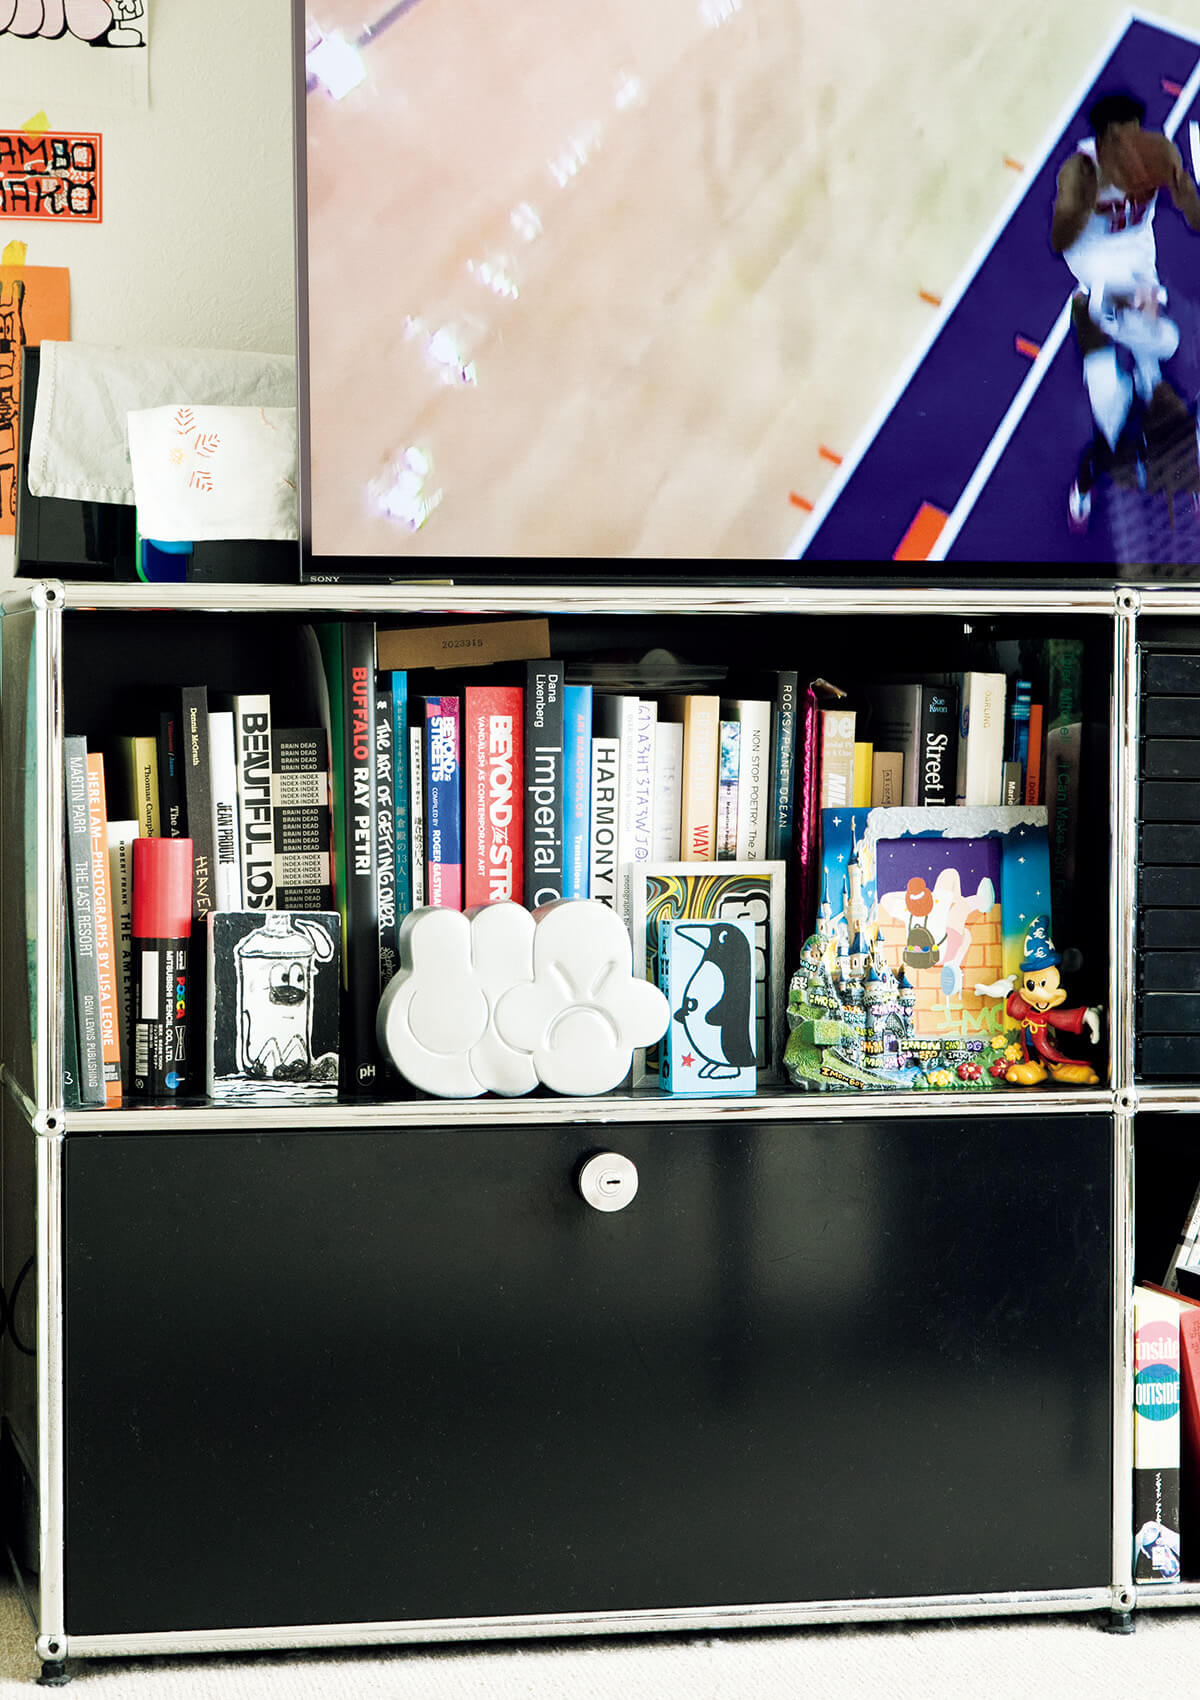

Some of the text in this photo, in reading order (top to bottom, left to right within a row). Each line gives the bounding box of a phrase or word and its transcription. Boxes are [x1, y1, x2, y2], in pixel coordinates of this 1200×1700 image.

[534, 674, 546, 728] Lixenberg
[548, 674, 558, 703] Dana
[932, 696, 945, 705] Sue
[929, 705, 948, 713] Kwon
[431, 716, 444, 783] STREETS
[443, 716, 457, 773] BEYOND
[751, 730, 761, 752] NON
[352, 667, 371, 875] BUFFALO RAY PETRI
[489, 716, 513, 827] BEYOND
[751, 755, 760, 783] STOP
[924, 733, 949, 792] Street
[70, 757, 85, 803] MARTIN
[88, 772, 100, 806] HERE
[144, 765, 152, 801] Thomas
[242, 713, 272, 855] BEAUTIFUL
[377, 786, 392, 806] OF
[477, 716, 487, 877] VANDALISM AS CONTEMPORARY ART
[528, 747, 562, 873] Imperial
[749, 785, 760, 825] POETRY
[73, 805, 87, 834] PARR
[170, 806, 179, 826] The
[217, 802, 233, 827] JEAN
[432, 818, 439, 827] BY
[595, 748, 616, 884] HARMONY
[378, 811, 394, 885] GETTING
[432, 829, 442, 863] ROGER
[693, 825, 710, 857] WAY
[748, 831, 758, 848] The
[75, 862, 89, 885] THE
[76, 886, 91, 913] LAST
[78, 916, 93, 957] RESORT
[121, 913, 131, 942] THE
[97, 952, 109, 969] BY
[165, 950, 174, 997] MITSUBISHI
[98, 975, 111, 1001] LISA
[176, 976, 186, 1019] POSCA
[101, 1004, 114, 1046] LEONE
[165, 999, 174, 1028] PENCIL
[85, 1019, 96, 1042] LEWIS
[88, 1043, 98, 1088] PUBLISHING
[359, 1065, 376, 1080] pH
[1135, 1337, 1179, 1362] inside
[1135, 1383, 1180, 1406] OUTSIDE
